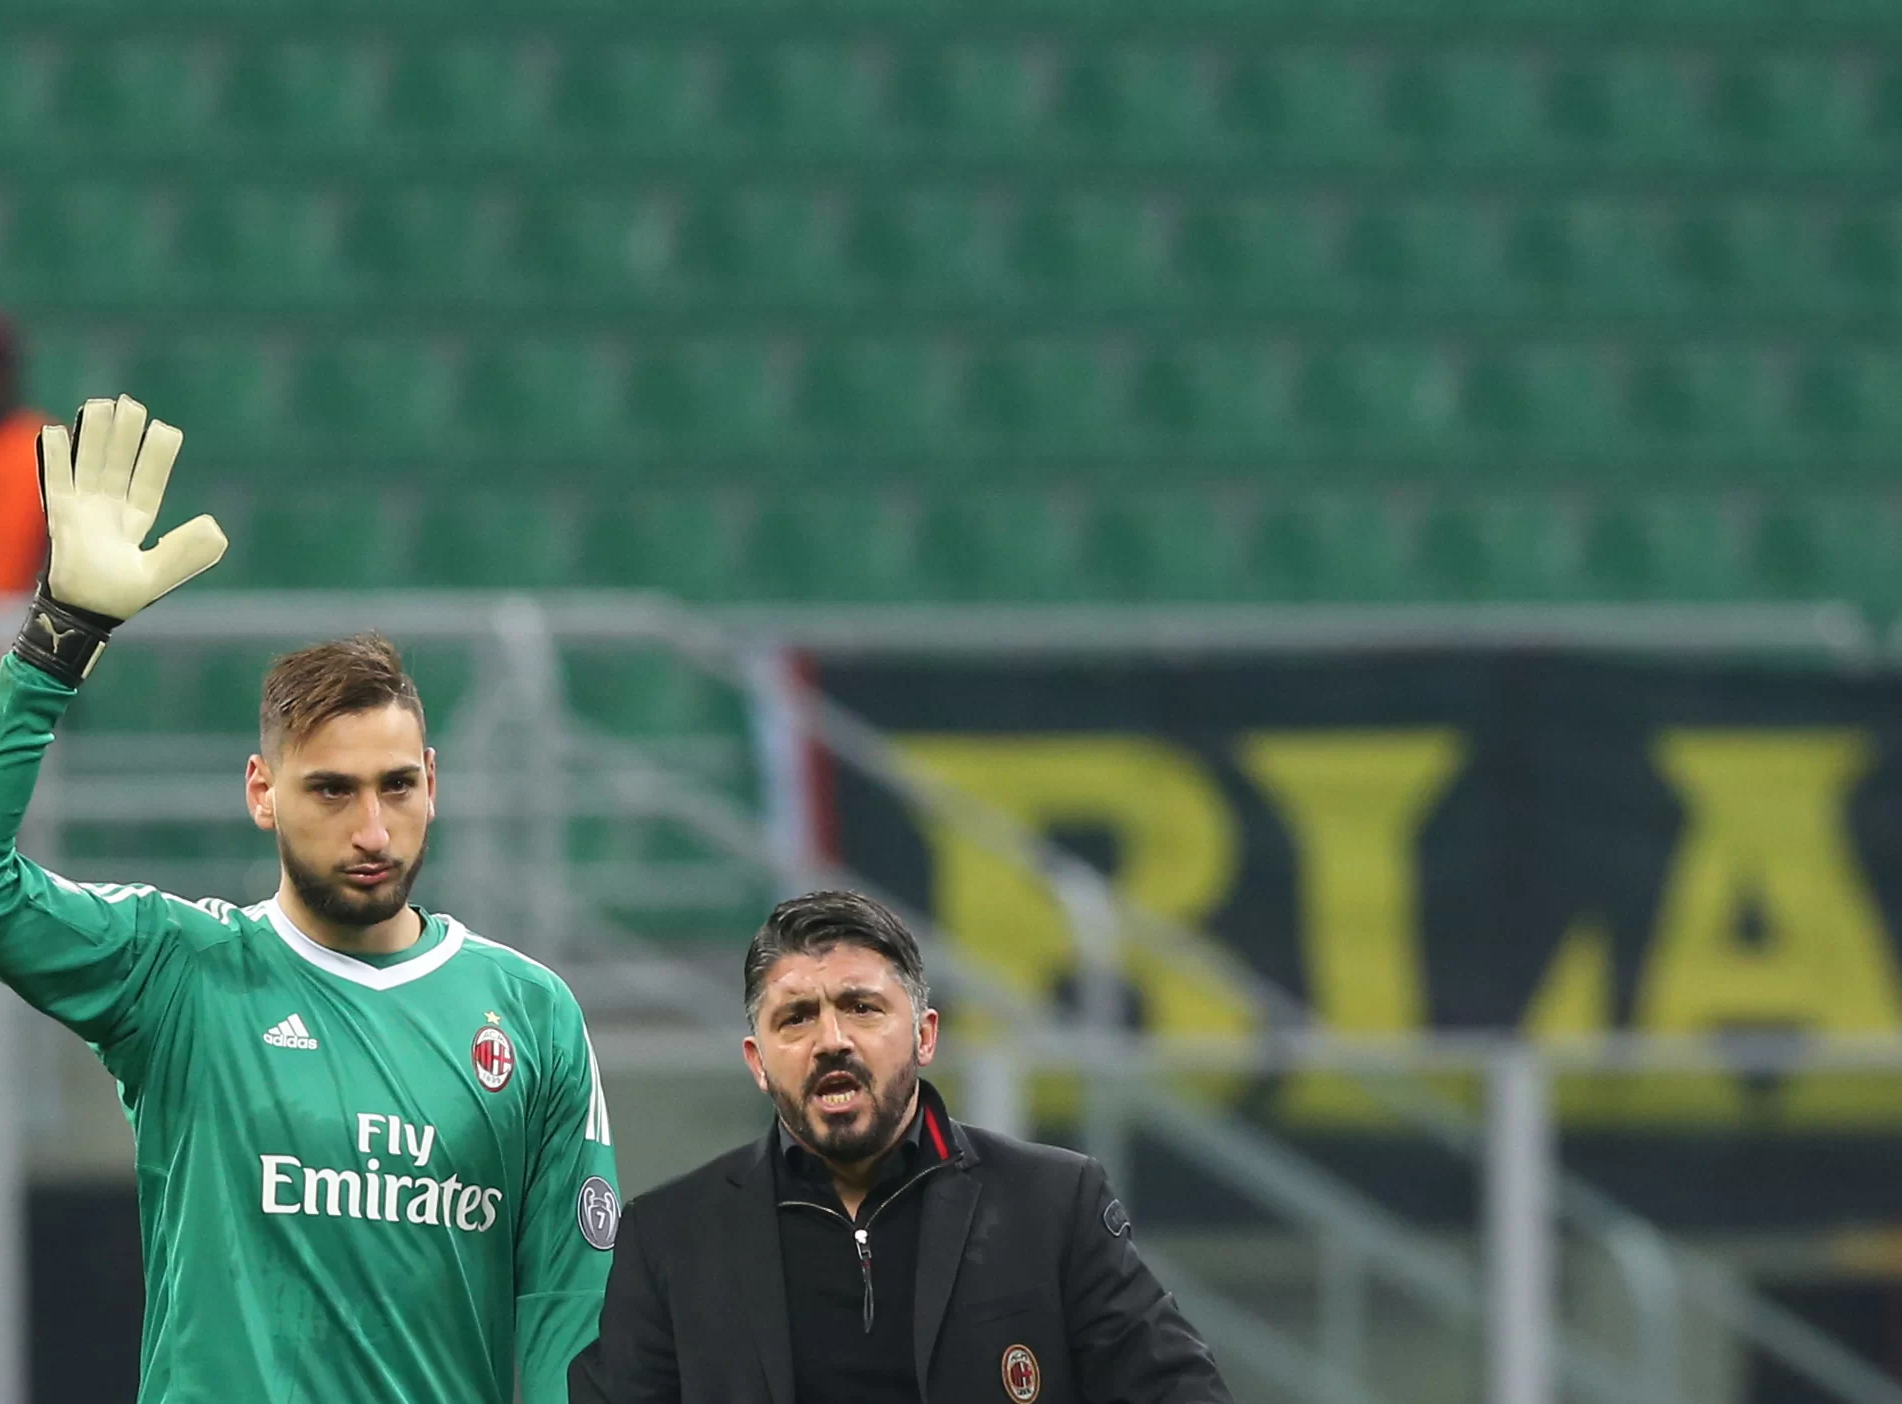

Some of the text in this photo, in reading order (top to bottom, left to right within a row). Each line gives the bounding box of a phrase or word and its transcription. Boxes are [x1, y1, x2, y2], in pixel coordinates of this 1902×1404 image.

[263, 1033, 318, 1050] adidas
[357, 1112, 436, 1167] Fly
[259, 1154, 503, 1233] Emirates
